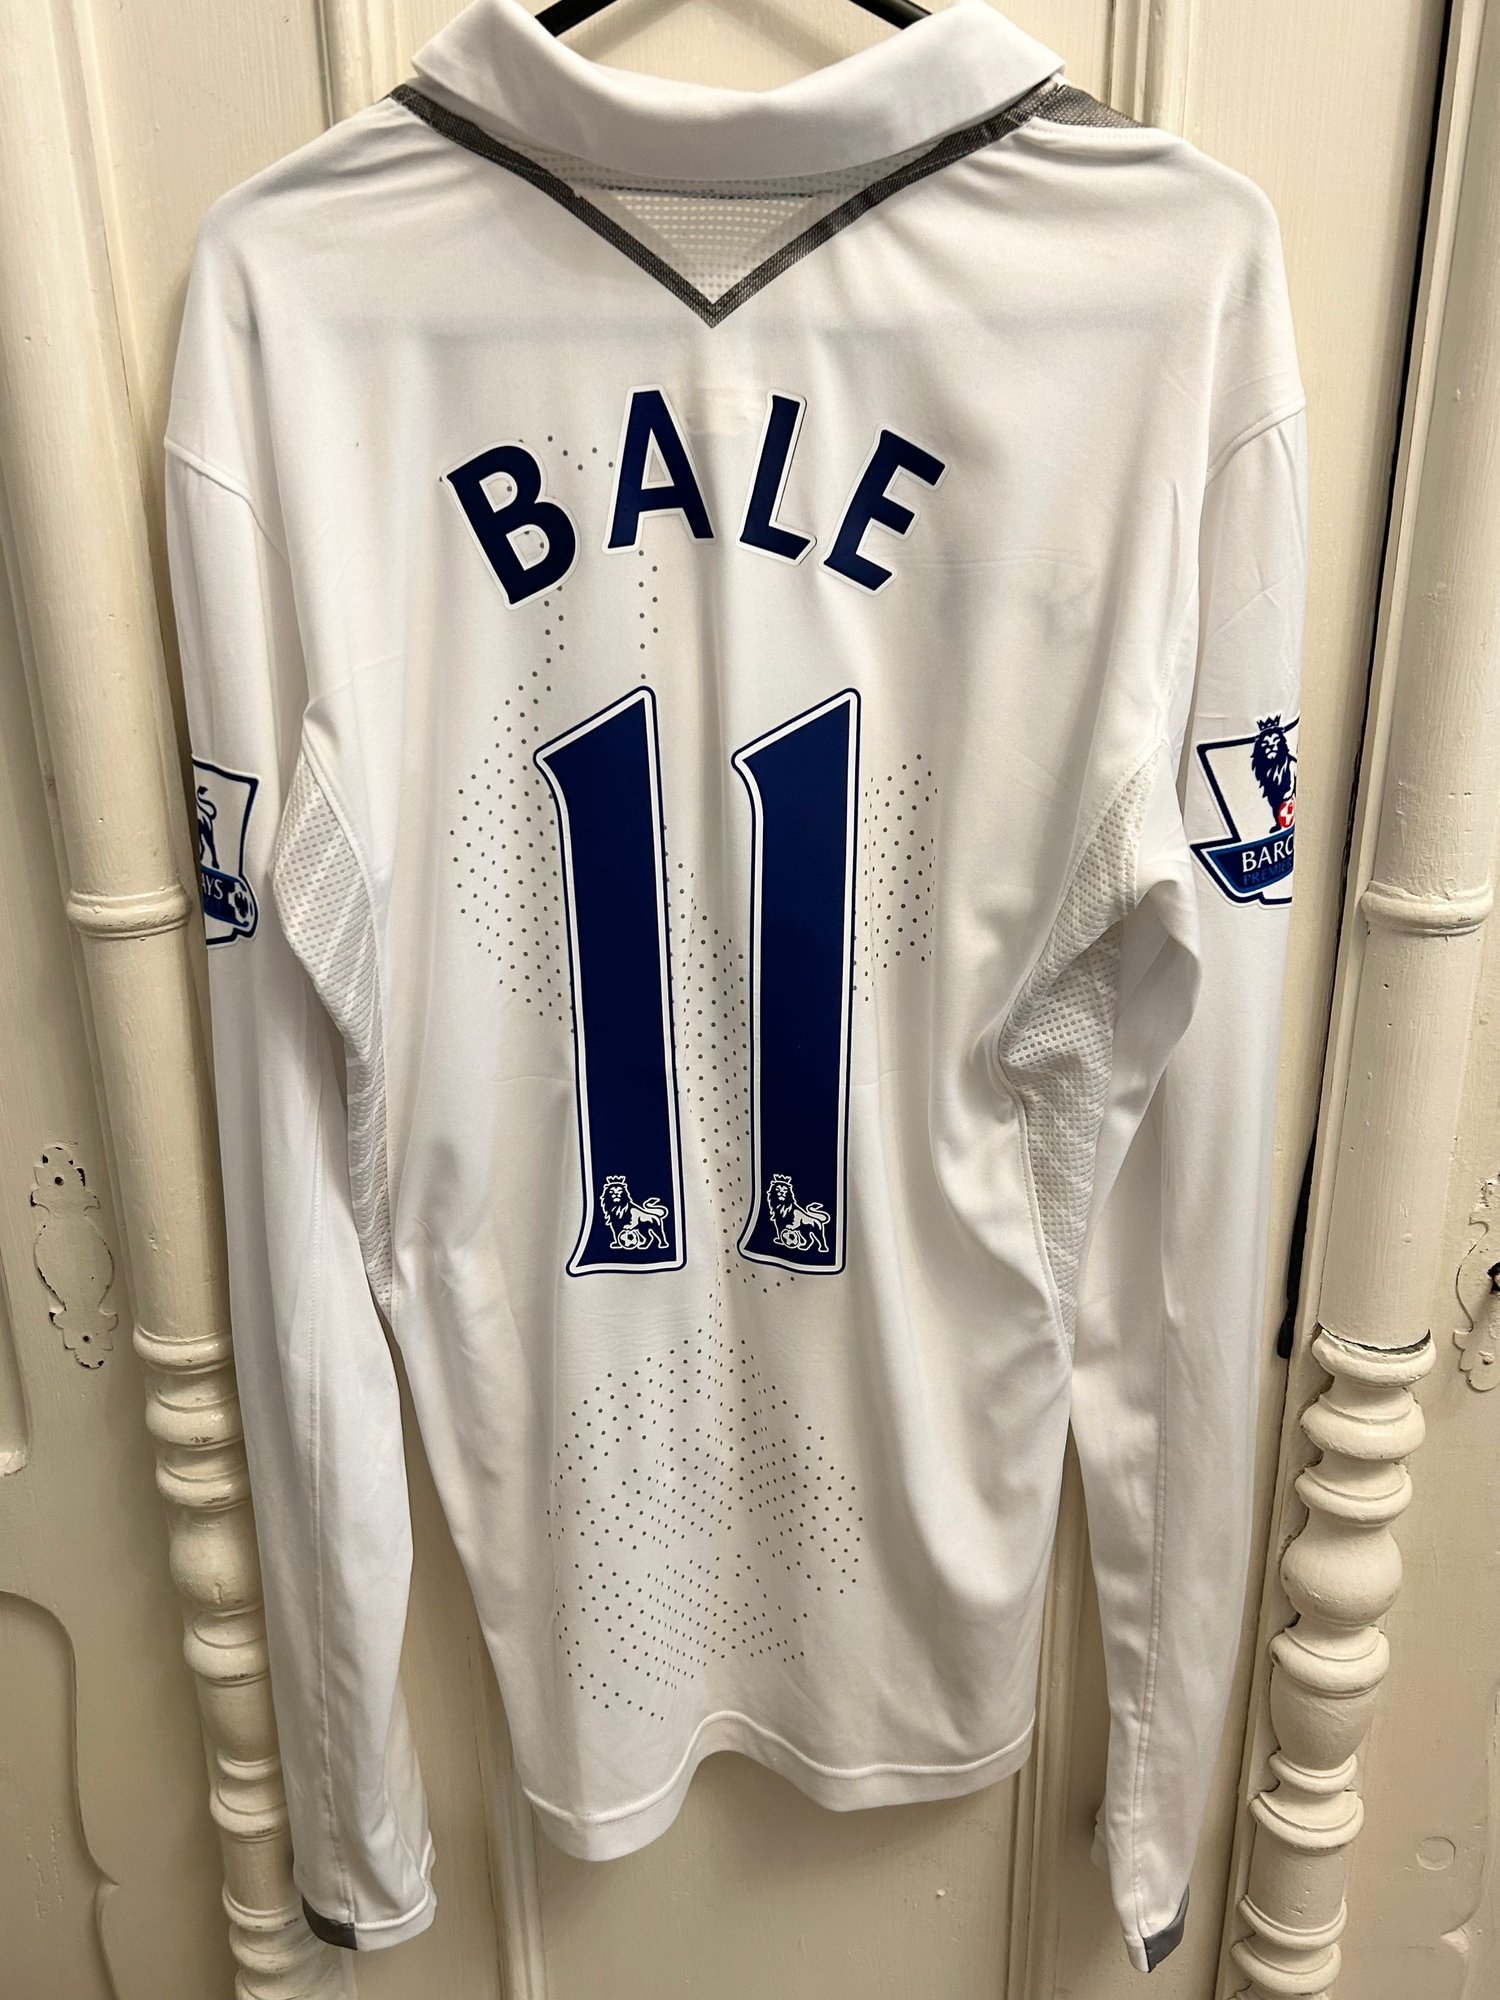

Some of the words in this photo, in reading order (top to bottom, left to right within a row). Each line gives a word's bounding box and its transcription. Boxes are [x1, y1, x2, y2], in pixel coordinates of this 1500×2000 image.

[445, 388, 947, 606] BALE
[1241, 833, 1294, 873] BARC
[533, 686, 861, 1276] 11
